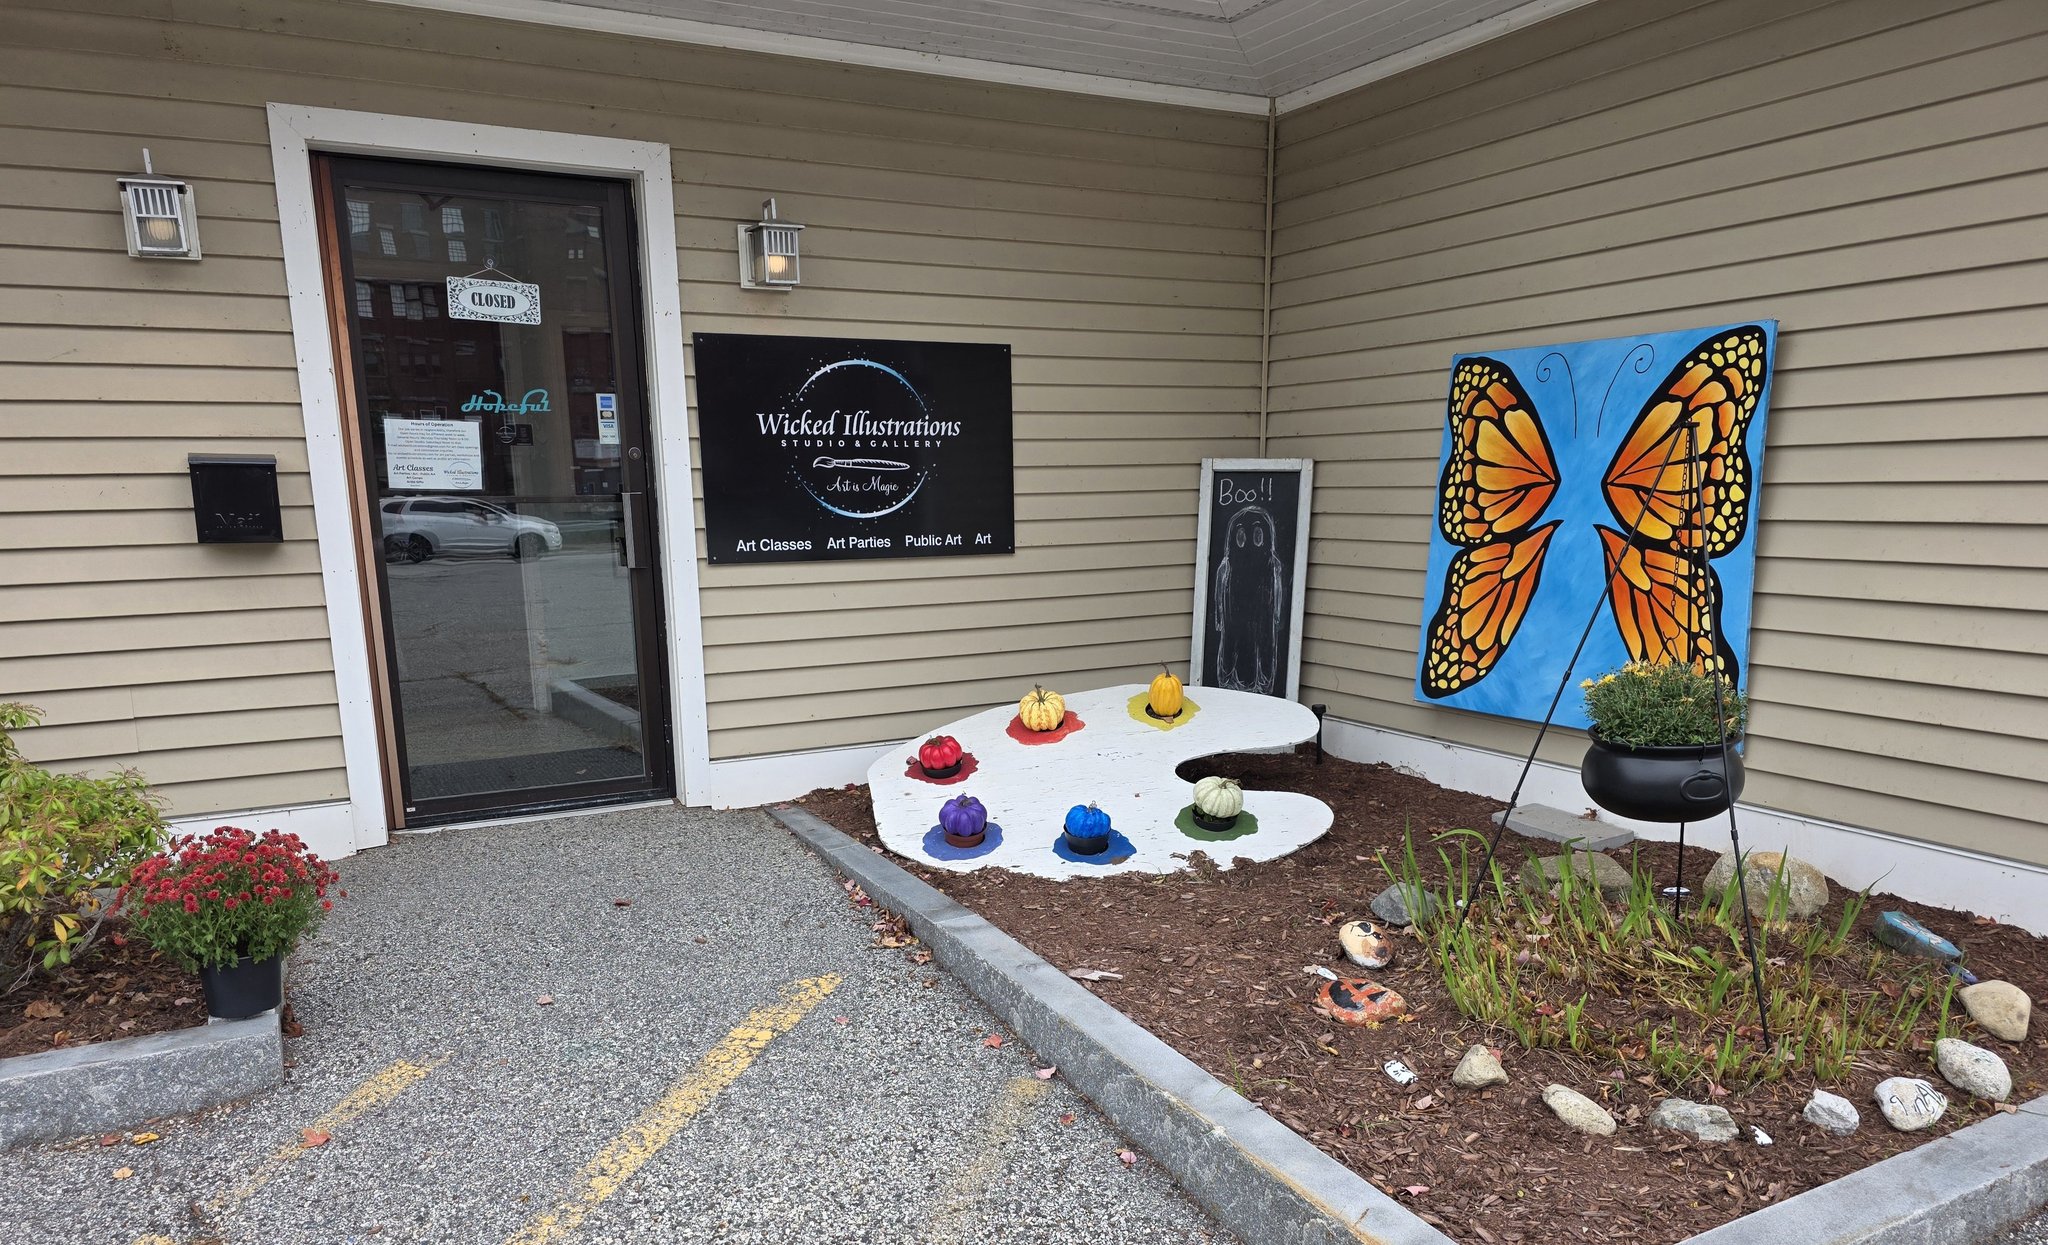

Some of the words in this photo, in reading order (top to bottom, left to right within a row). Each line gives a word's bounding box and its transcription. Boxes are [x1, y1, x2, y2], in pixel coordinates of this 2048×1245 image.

[471, 292, 516, 309] CLOSED
[461, 388, 551, 415] Hopeful
[756, 410, 840, 436] Wicked
[842, 410, 962, 437] Illustrations
[781, 439, 846, 448] STUDIO
[854, 439, 861, 448] &
[870, 439, 942, 448] GALLERY
[406, 464, 434, 472] Classes
[826, 475, 851, 492] Art
[852, 482, 860, 492] is
[862, 475, 899, 496] Magic
[1218, 477, 1273, 506] Boo!!
[736, 539, 757, 552] Art
[759, 538, 813, 552] Classes
[827, 537, 846, 550] Art
[849, 536, 892, 549] Parties
[905, 534, 943, 547] Public
[945, 533, 963, 546] Art
[974, 532, 992, 545] Art
